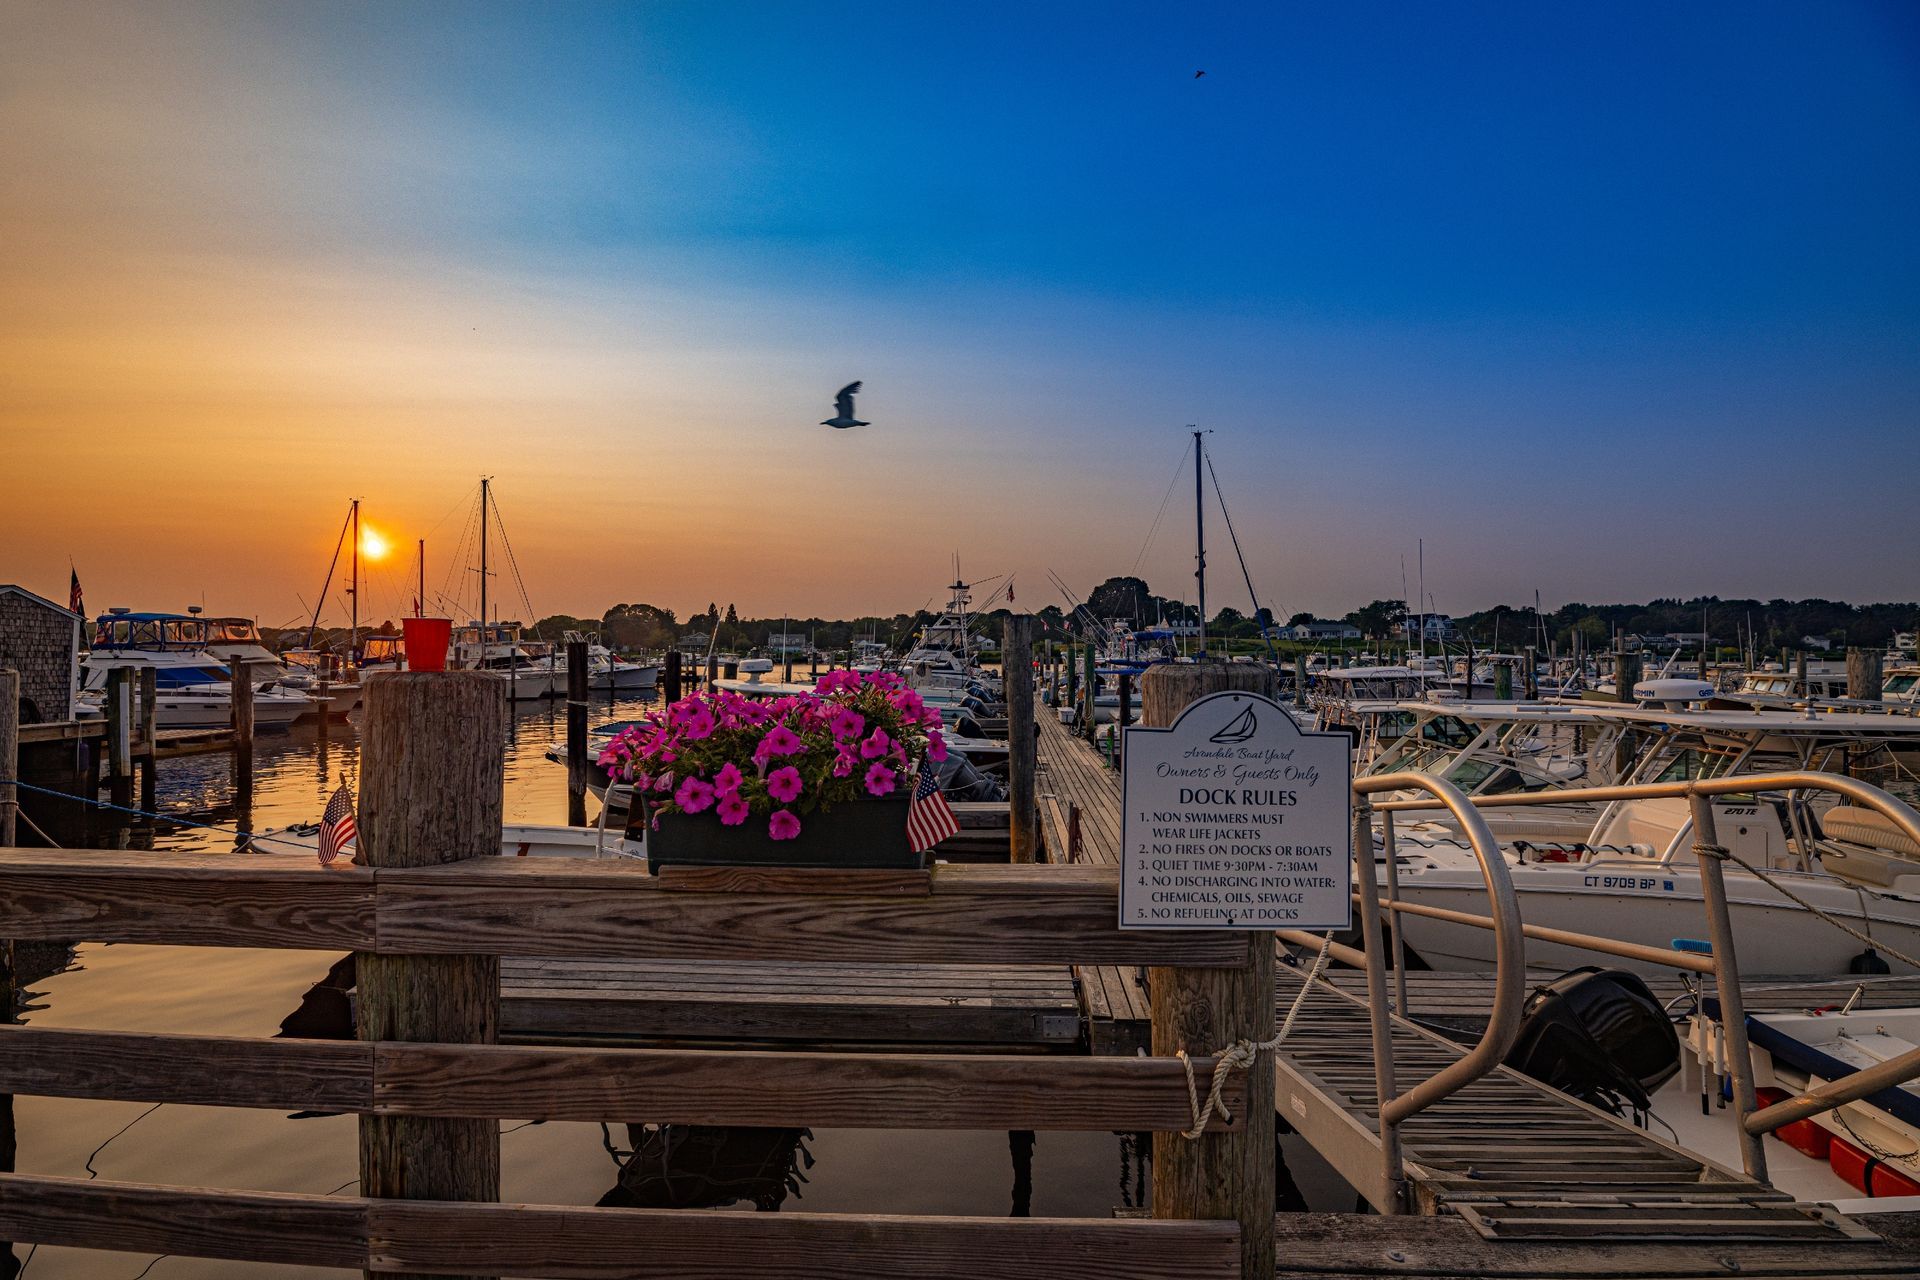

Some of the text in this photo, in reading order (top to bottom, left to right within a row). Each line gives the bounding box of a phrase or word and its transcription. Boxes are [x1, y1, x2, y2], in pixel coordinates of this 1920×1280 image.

[1184, 747, 1291, 764] Avondale Boat Yard
[1156, 762, 1320, 787] Owners & Guests Only
[1179, 788, 1297, 806] DOCK RULES
[1140, 812, 1284, 824] 1. NON SWIMMERS MUST
[1153, 828, 1261, 841] WEAR LIFE JACKETS
[1139, 844, 1332, 856] 2. NO FIRES ON DOCKS OR BOATS
[1138, 860, 1148, 870] 3.
[1153, 860, 1189, 872] QUIET
[1192, 861, 1220, 871] TIME
[1277, 862, 1318, 872] 7:30AM
[1138, 876, 1336, 888] 4. NO DISCHARGING INTO WATER:
[1584, 876, 1599, 887] CT
[1603, 877, 1636, 889] 9709
[1640, 878, 1656, 890] BP
[1152, 892, 1303, 904] CHEMICALS, OILS, SEWAGE
[1138, 908, 1298, 919] 5. NO REFUELING AT DOCKS
